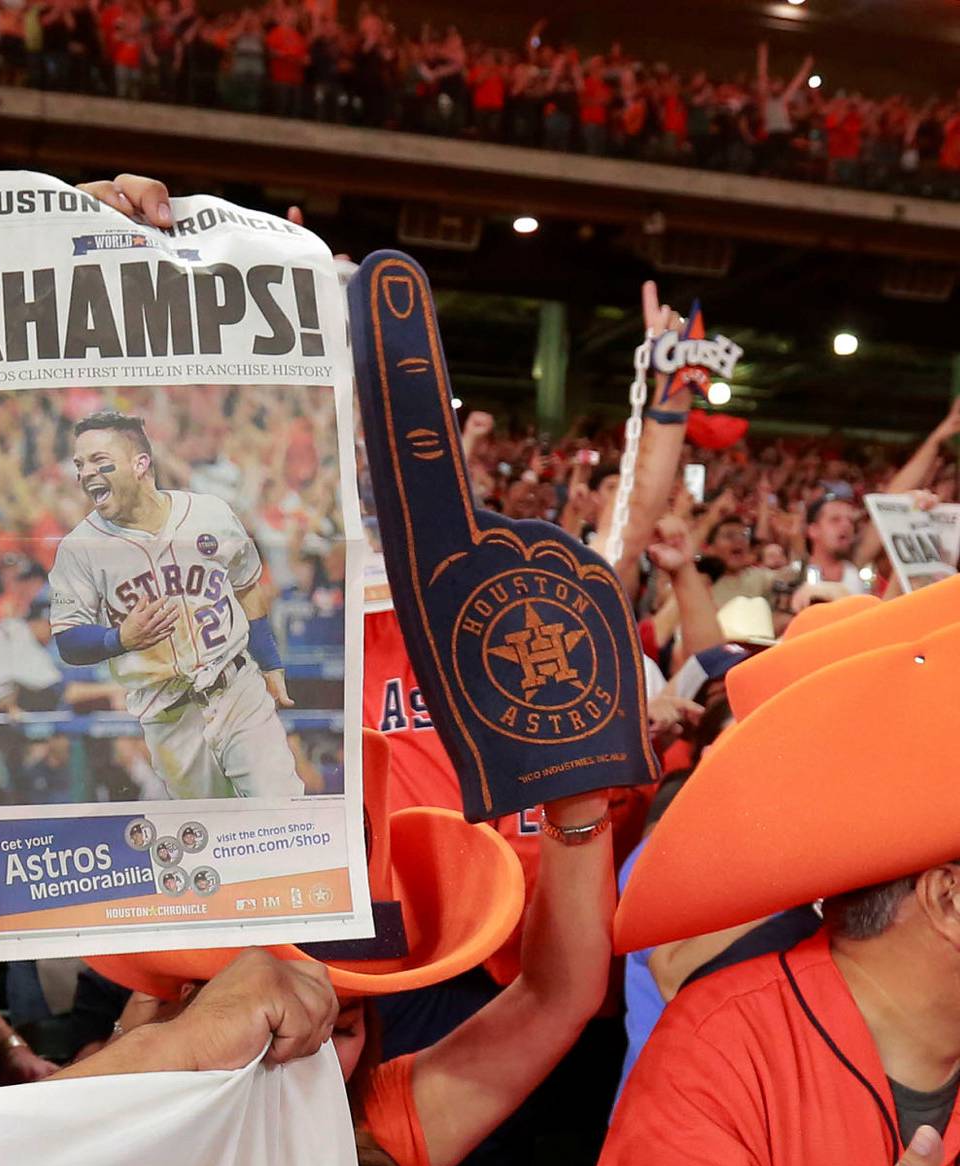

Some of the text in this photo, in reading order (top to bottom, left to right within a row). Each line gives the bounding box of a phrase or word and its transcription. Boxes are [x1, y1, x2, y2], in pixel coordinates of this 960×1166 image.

[158, 208, 304, 238] RONICLE
[95, 234, 132, 249] WORLD
[18, 367, 74, 381] CLINCH
[77, 366, 119, 378] FIRST
[121, 365, 164, 378] TITLE
[167, 365, 182, 377] IN
[187, 364, 270, 377] FRANCHISE
[272, 364, 333, 378] HISTORY
[461, 575, 590, 637] HOUSTON
[498, 685, 612, 735] ASTROS
[1, 834, 54, 851] Get your
[213, 831, 331, 860] Chron.com/Shop
[216, 821, 316, 843] visit the Chron Shop:
[6, 843, 113, 885] Astros
[30, 866, 154, 901] Memorabilia
[105, 903, 208, 919] HOUSTON CHRONICLE
